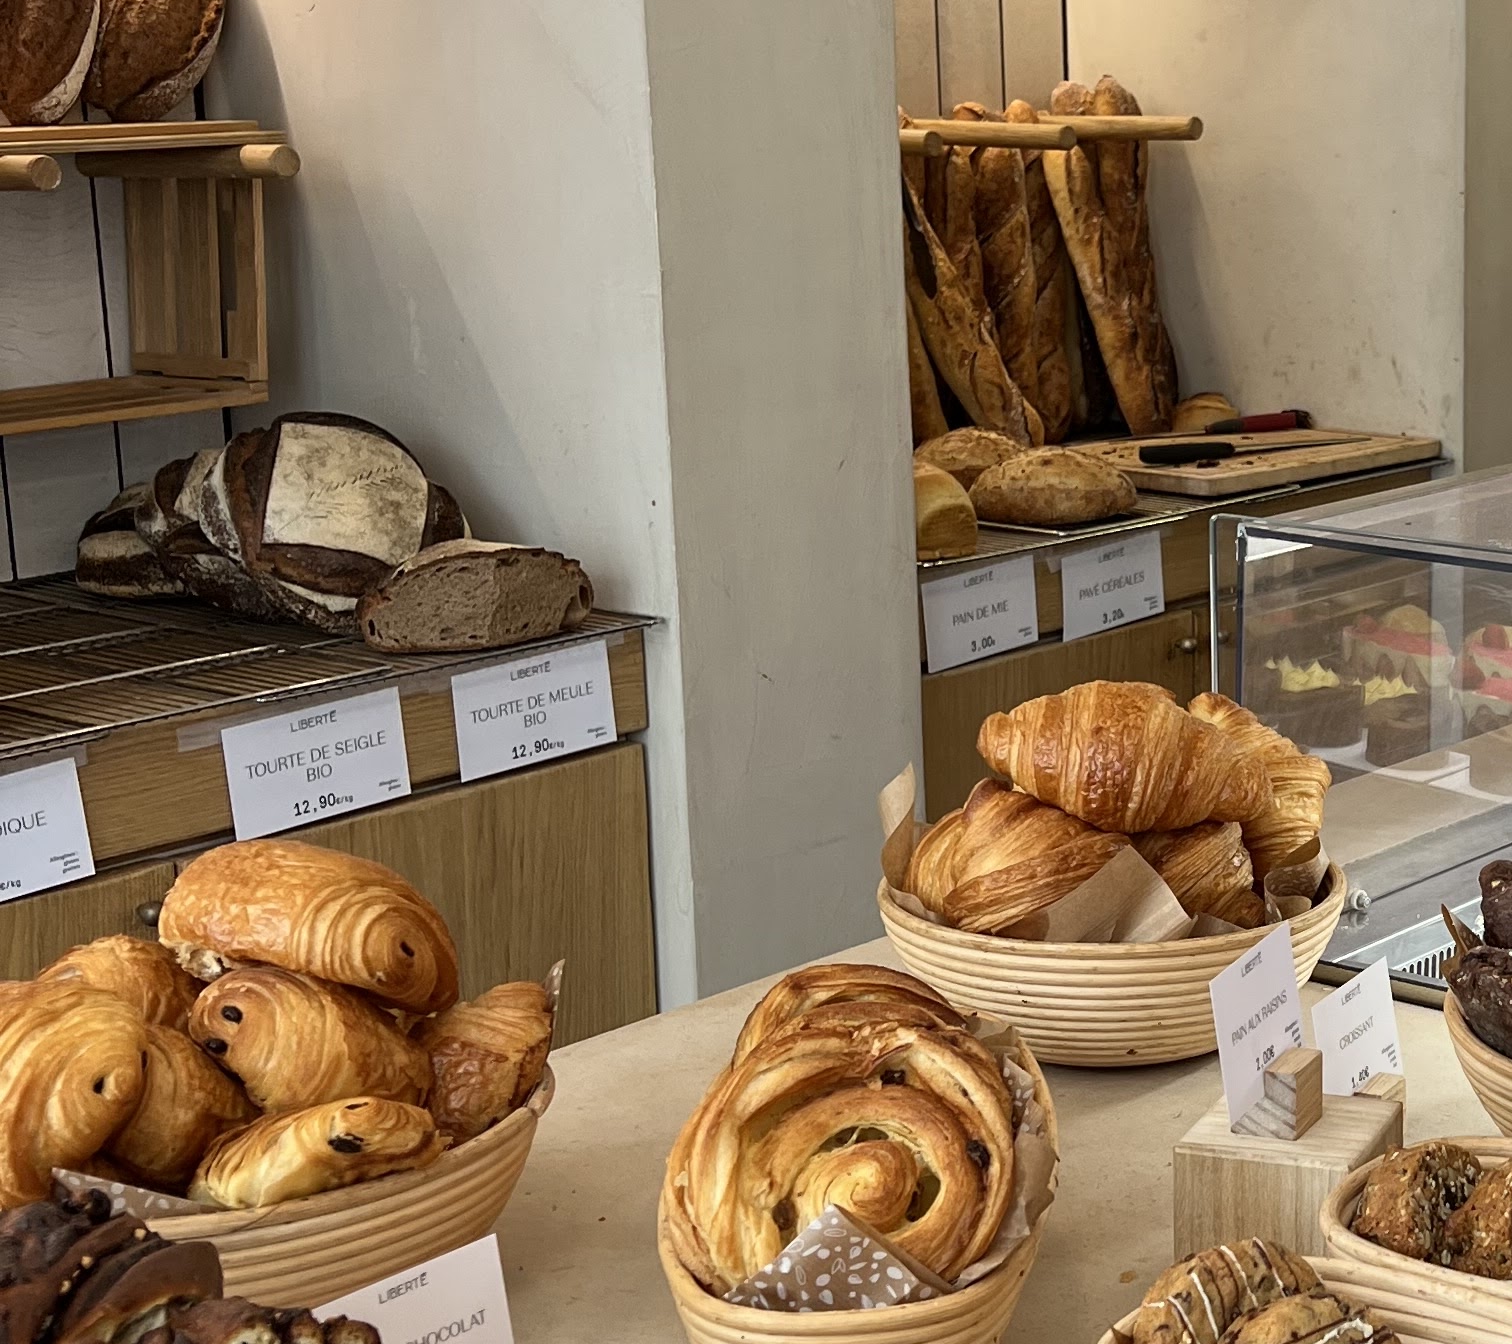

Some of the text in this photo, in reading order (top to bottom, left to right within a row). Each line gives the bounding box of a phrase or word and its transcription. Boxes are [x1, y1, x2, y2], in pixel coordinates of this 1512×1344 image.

[1079, 570, 1145, 600] PAVÉ CÉRÉALES
[952, 599, 1009, 627] PAIN DE MIE
[470, 680, 594, 724] TOURTE DE MEULE
[523, 710, 547, 729] BIO
[245, 730, 387, 780] TOURTE DE SEIGLE
[306, 763, 333, 783] BIO
[1231, 989, 1288, 1047] PAIN AUX RAISINS
[1339, 1015, 1374, 1051] CROISSANT
